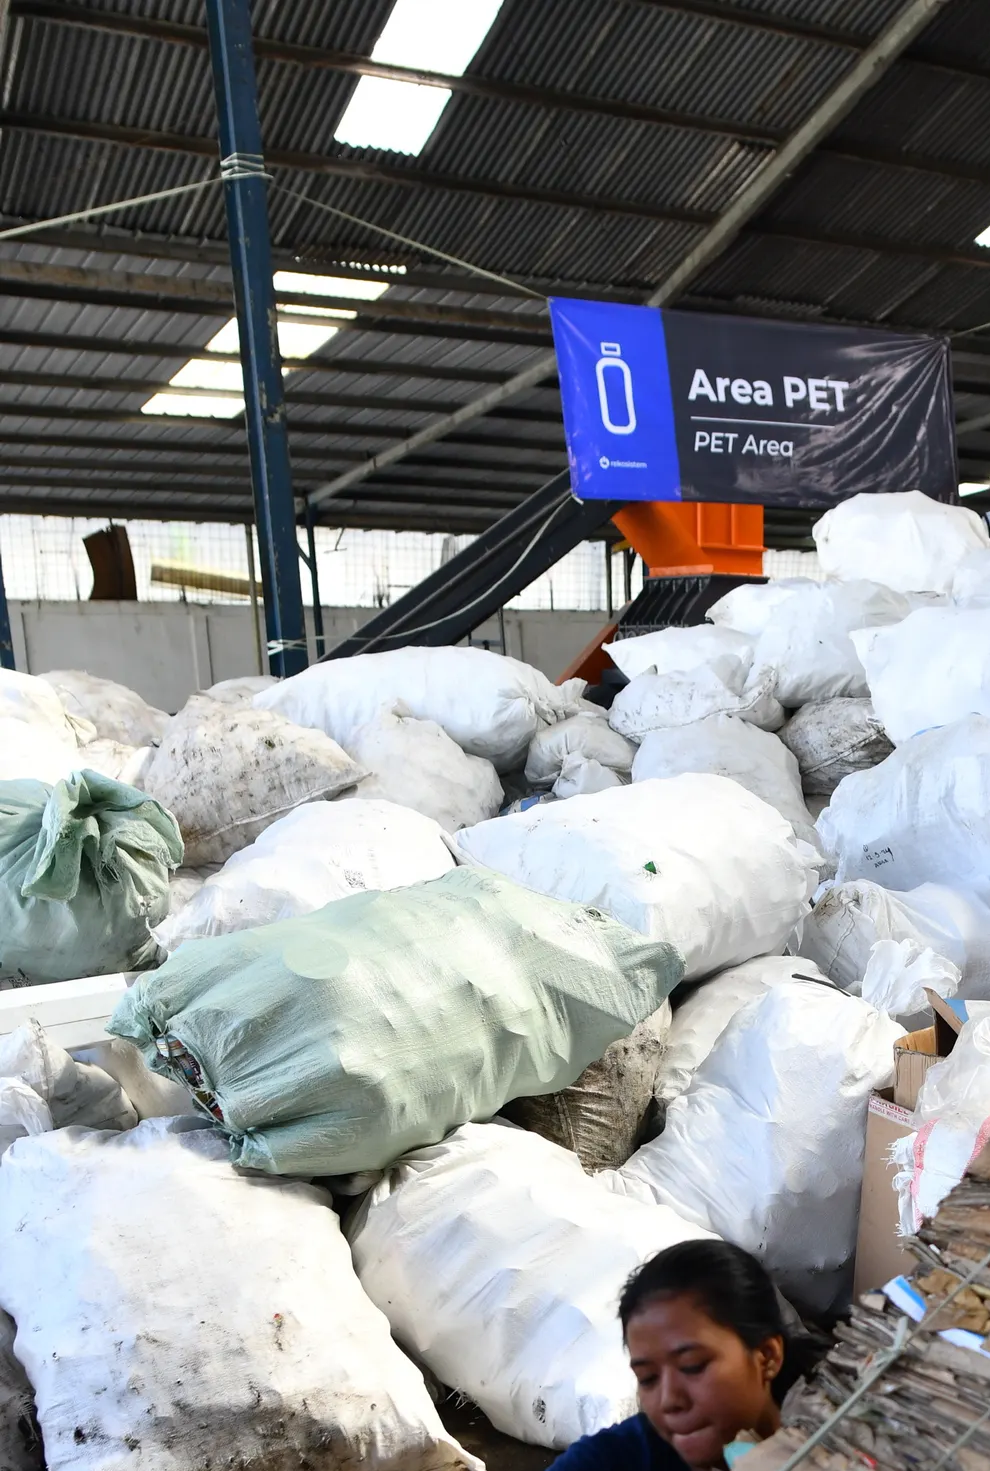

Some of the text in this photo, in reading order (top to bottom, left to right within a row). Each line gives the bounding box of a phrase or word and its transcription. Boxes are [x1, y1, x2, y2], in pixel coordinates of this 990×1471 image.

[687, 368, 850, 412] Area PET
[694, 431, 794, 457] PET Area
